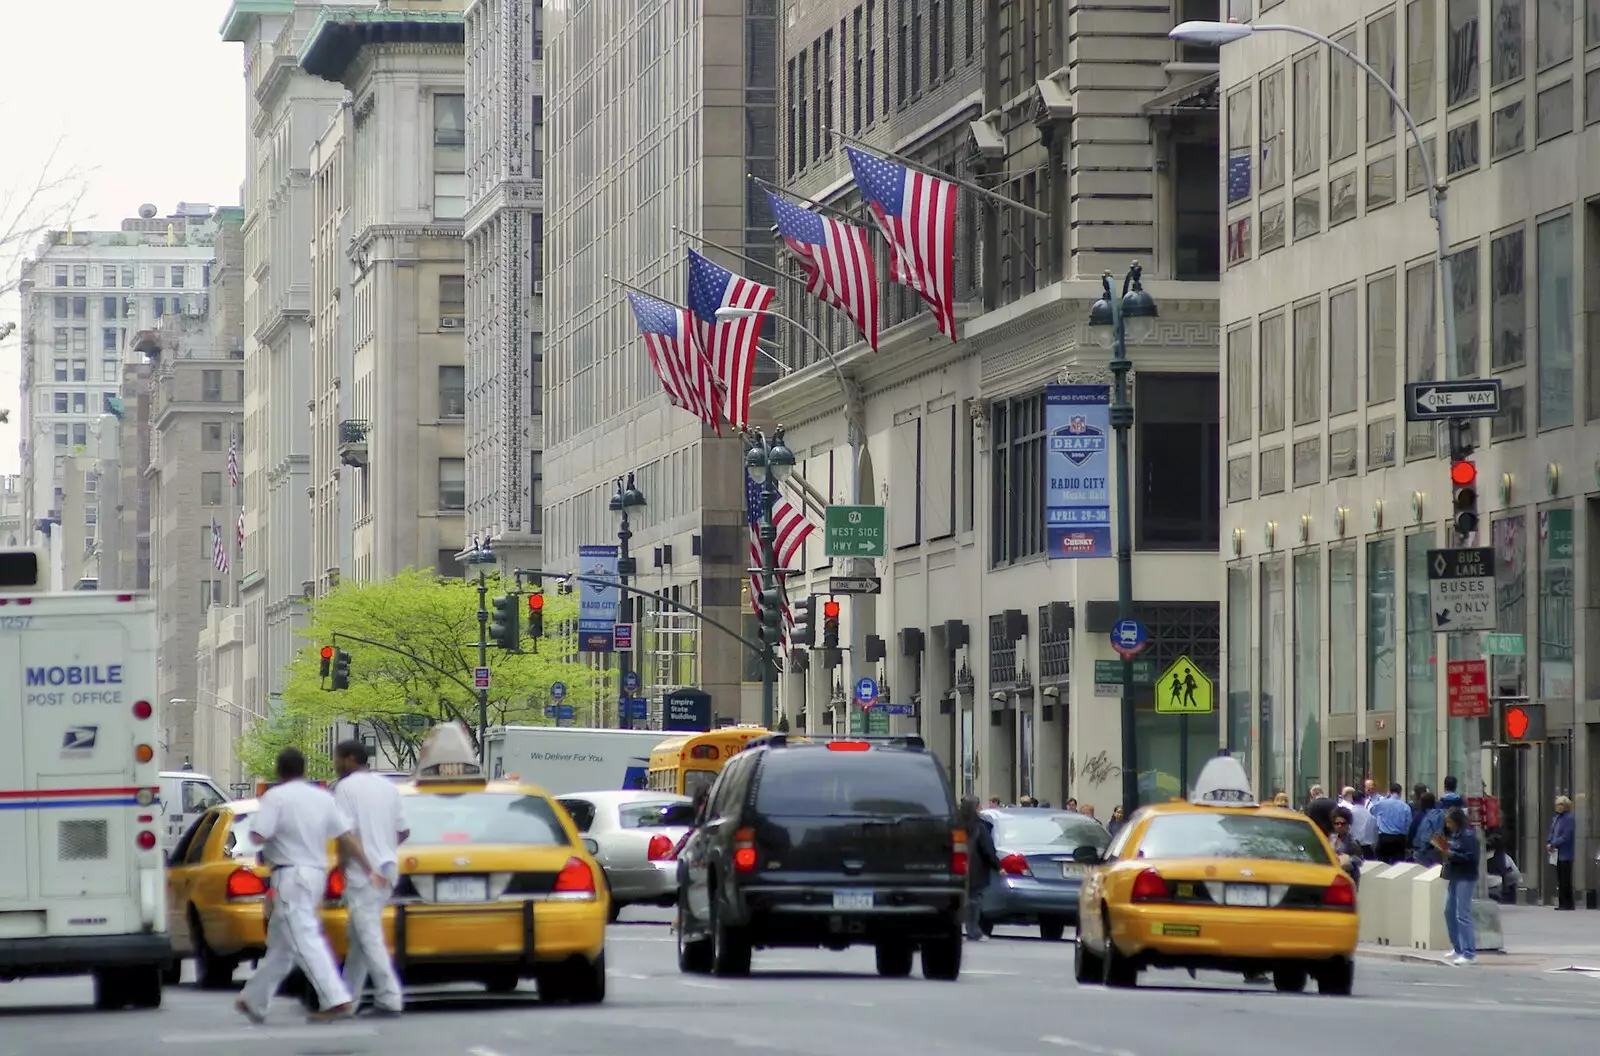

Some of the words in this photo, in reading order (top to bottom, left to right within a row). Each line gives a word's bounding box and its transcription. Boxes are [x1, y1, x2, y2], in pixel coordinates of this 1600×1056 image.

[1428, 394, 1452, 405] ONE
[1467, 392, 1491, 403] WAY
[1071, 422, 1085, 431] NFL
[1054, 438, 1102, 449] DRAFT
[1051, 478, 1080, 489] RADIO
[1083, 477, 1105, 489] CITY
[1050, 510, 1077, 520] APRIL
[1081, 510, 1106, 520] 29-30
[831, 528, 854, 537] WEST
[858, 528, 878, 536] SIDE
[833, 542, 852, 550] HWY
[1459, 551, 1481, 563] BUS
[1456, 563, 1486, 576] LANE
[1440, 580, 1485, 593] BUSES
[582, 601, 600, 609] RADIO
[601, 601, 616, 609] CITY
[1455, 601, 1489, 613] ONLY
[1499, 636, 1512, 652] 40
[26, 665, 123, 686] MOBILE
[27, 693, 65, 706] POST
[72, 691, 123, 705] OFFICE
[670, 713, 697, 721] Building
[530, 752, 543, 760] We
[544, 752, 572, 760] Deliver
[573, 753, 587, 761] For
